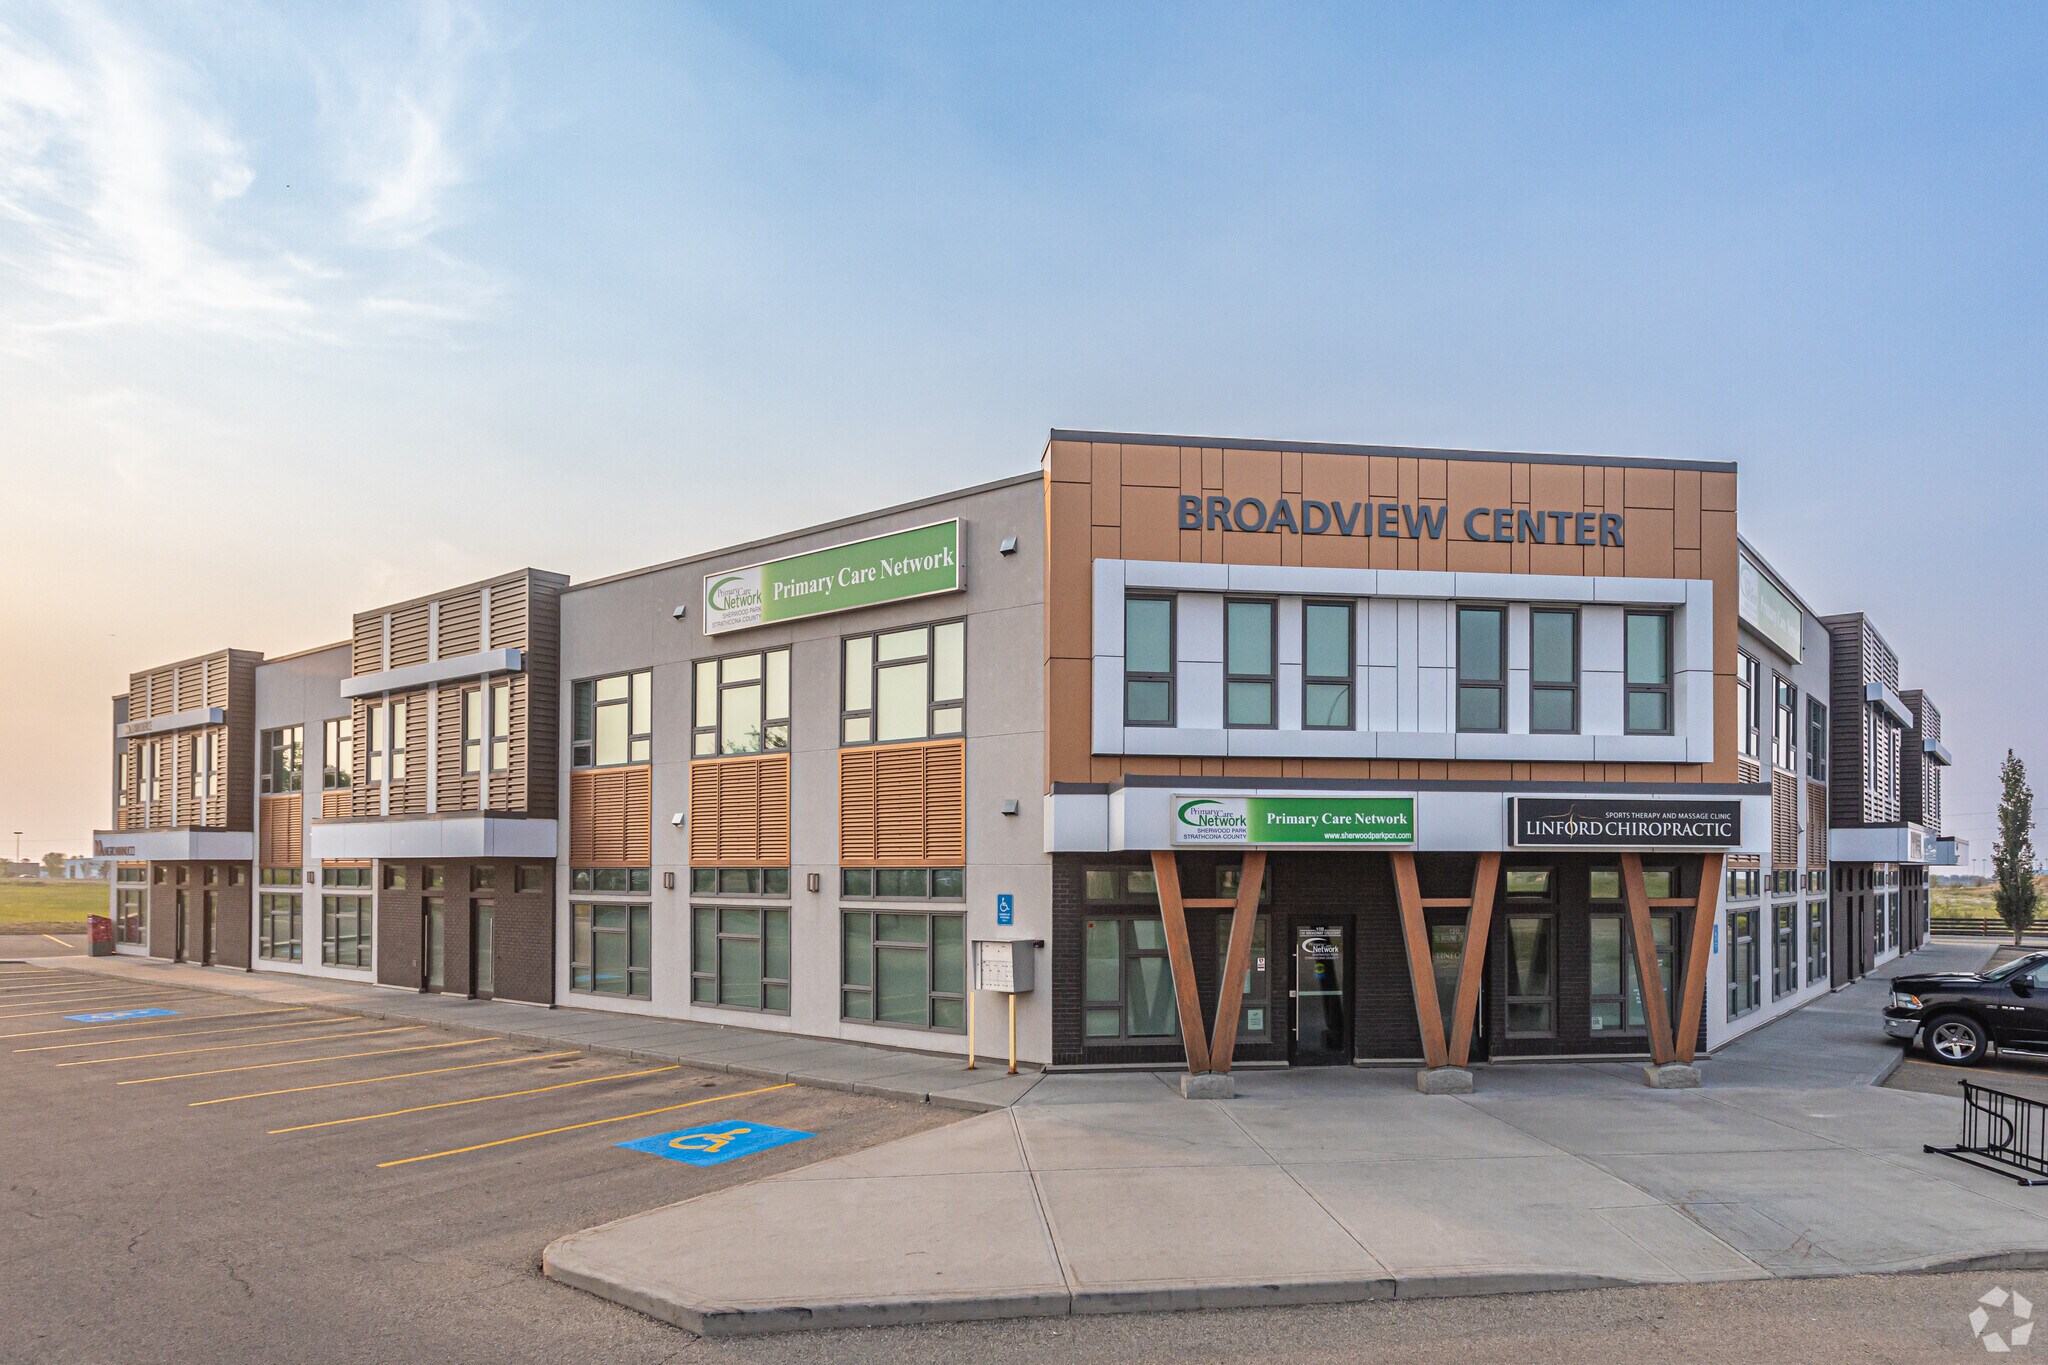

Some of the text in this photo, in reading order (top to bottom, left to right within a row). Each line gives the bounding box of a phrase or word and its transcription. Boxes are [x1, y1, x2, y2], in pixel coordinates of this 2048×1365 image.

[1179, 495, 1625, 547] BROADVIEW CENTER
[773, 546, 955, 601] Primary Care Network
[724, 590, 762, 610] Network
[1190, 807, 1234, 818] Primary Care
[1266, 812, 1408, 827] Primary Care Network
[1605, 811, 1631, 819] SPORTS
[1662, 812, 1677, 820] AND
[1678, 812, 1709, 820] MASSAGE
[1199, 814, 1247, 827] Network
[1324, 831, 1412, 841] www.sherwoodparkpcn.com
[1526, 820, 1732, 837] LINFORD CHIROPRACTIC
